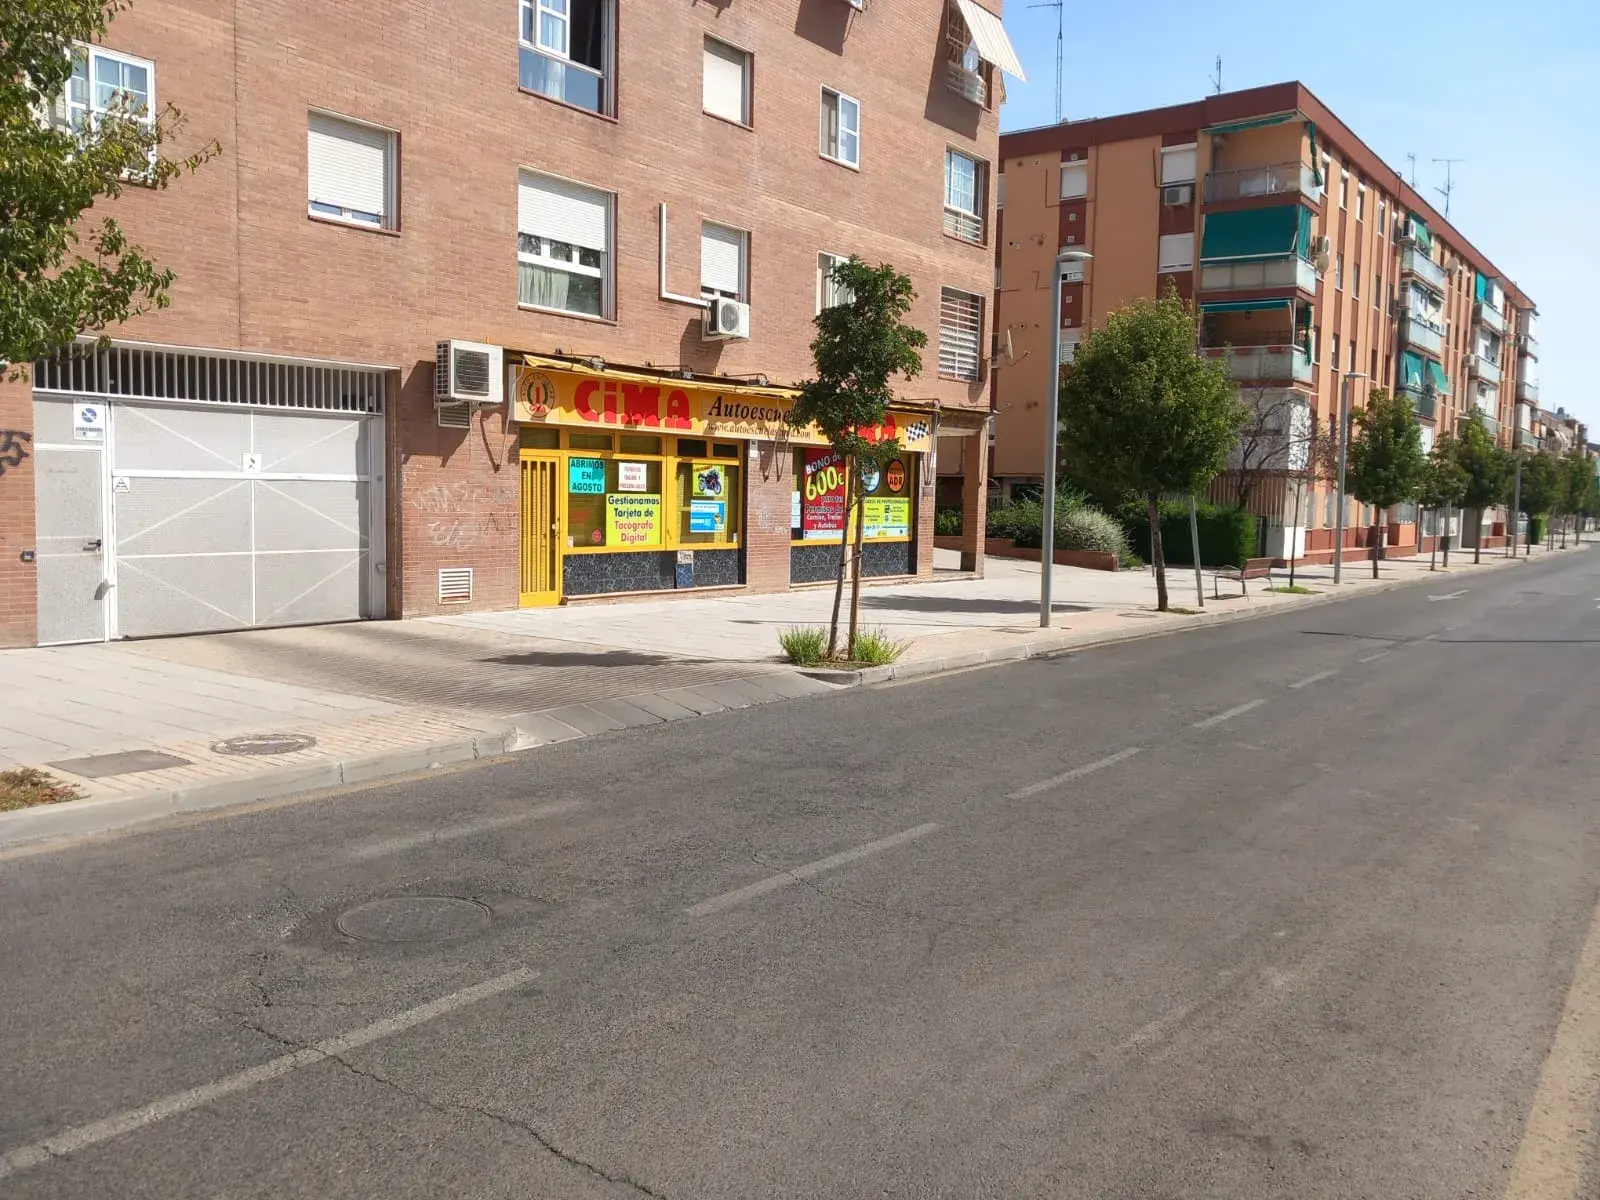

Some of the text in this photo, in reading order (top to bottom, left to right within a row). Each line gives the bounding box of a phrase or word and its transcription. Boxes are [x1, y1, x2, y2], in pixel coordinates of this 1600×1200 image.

[708, 395, 793, 422] Autoescue
[571, 459, 604, 469] ABRIMOS
[805, 455, 831, 476] BONO
[581, 471, 592, 480] EN
[889, 475, 903, 486] ADR
[572, 482, 602, 492] AGOSTO
[805, 466, 845, 501] 600€
[608, 495, 660, 505] Gestionamos
[614, 508, 654, 519] Tarjeta de
[805, 504, 843, 514] Permisos de
[614, 520, 654, 532] Tacógrafo
[621, 533, 647, 544] Digital
